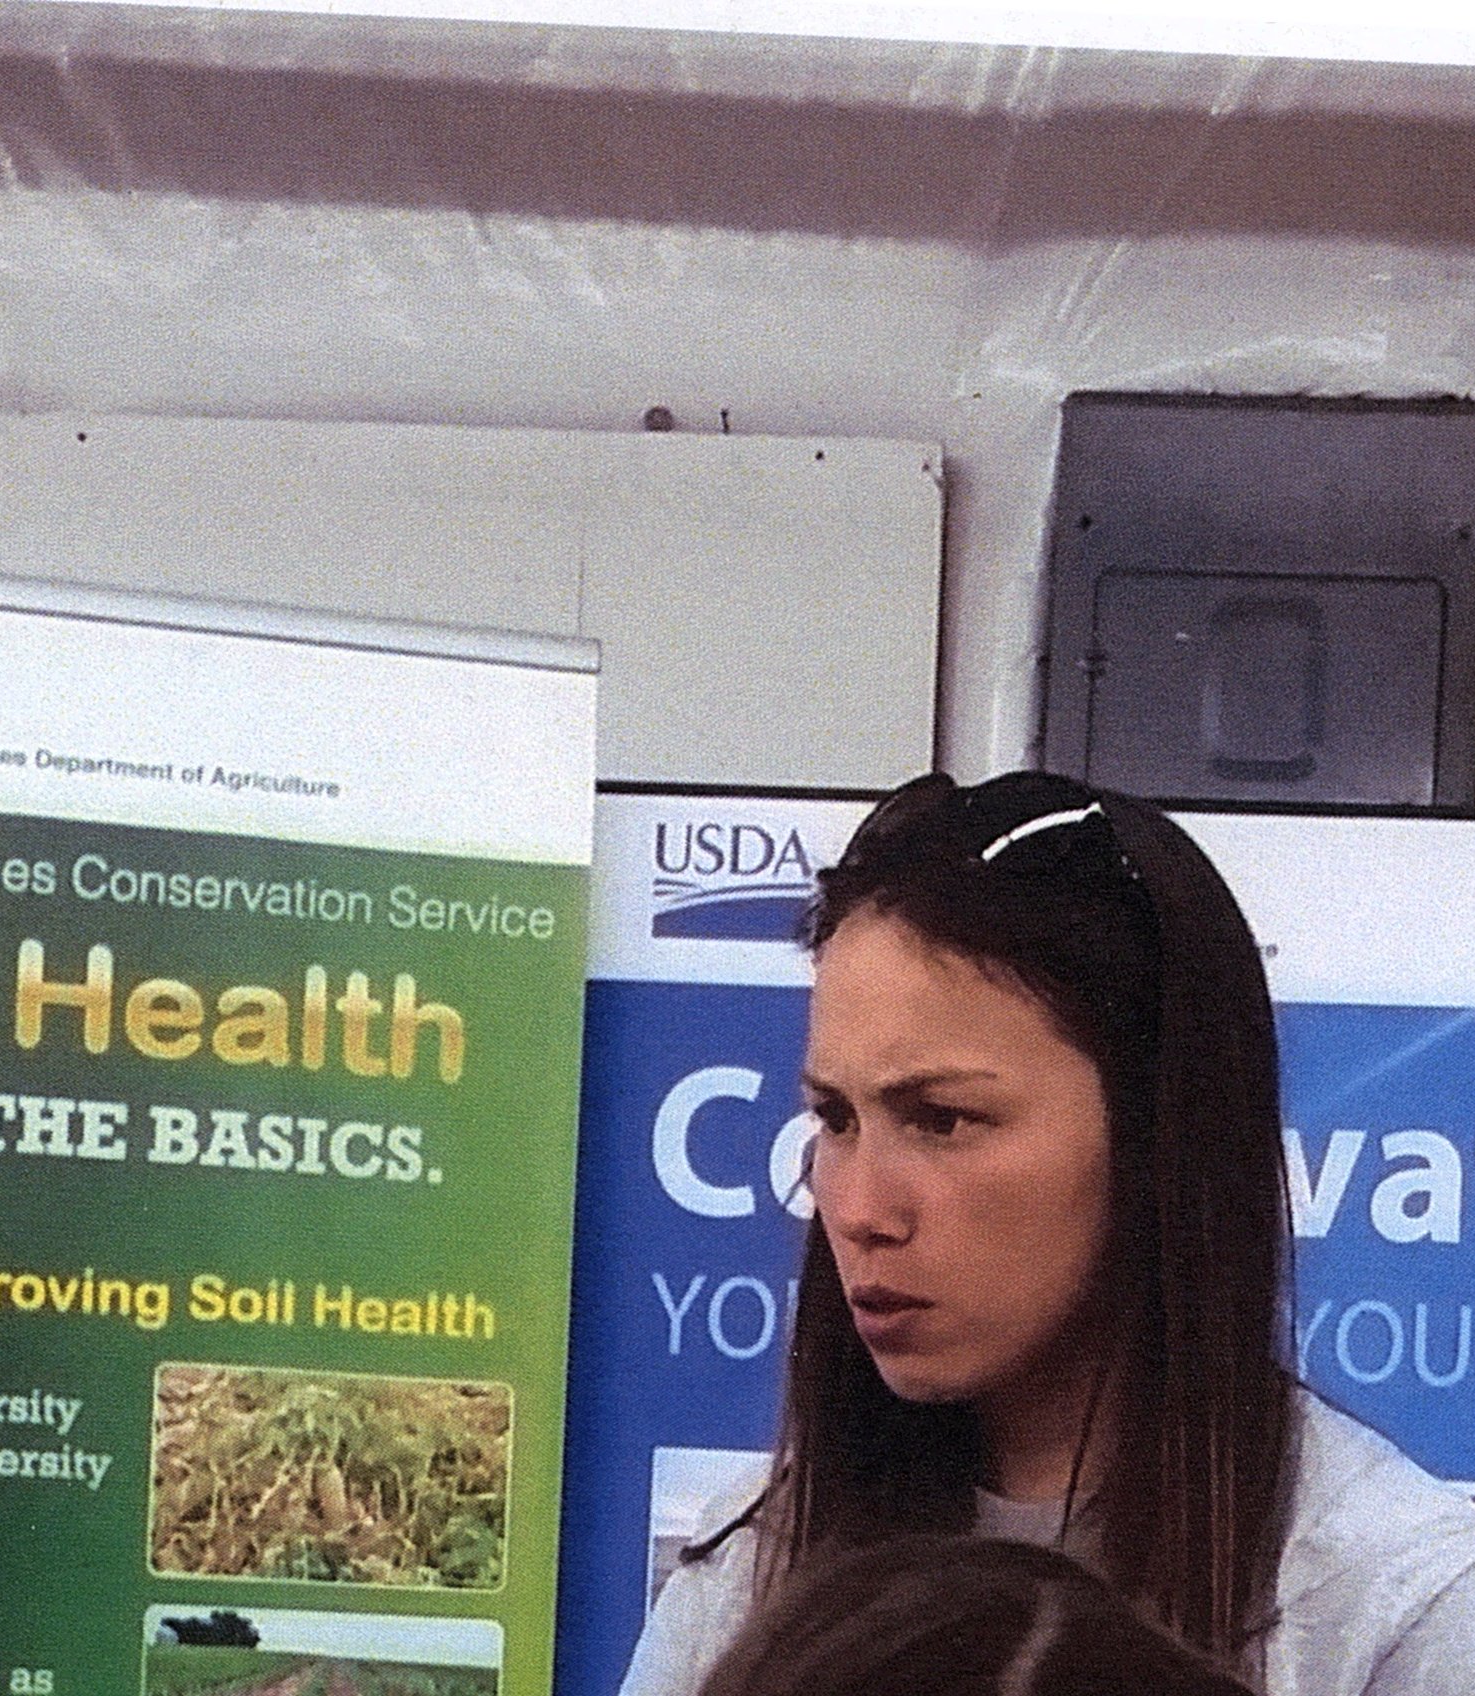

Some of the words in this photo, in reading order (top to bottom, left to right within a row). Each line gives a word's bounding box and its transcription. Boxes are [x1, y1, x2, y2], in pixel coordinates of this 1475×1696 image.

[35, 749, 173, 780] Department
[181, 766, 204, 782] of
[211, 767, 340, 797] Agriculture
[656, 824, 812, 877] USDA
[73, 855, 372, 923] Conservation
[389, 885, 556, 940] Service
[16, 939, 465, 1083] Health
[149, 1107, 442, 1183] BASICS.
[190, 1276, 295, 1324] Soil
[314, 1286, 495, 1339] Health
[652, 1273, 799, 1359] YO
[10, 1669, 53, 1694] as
